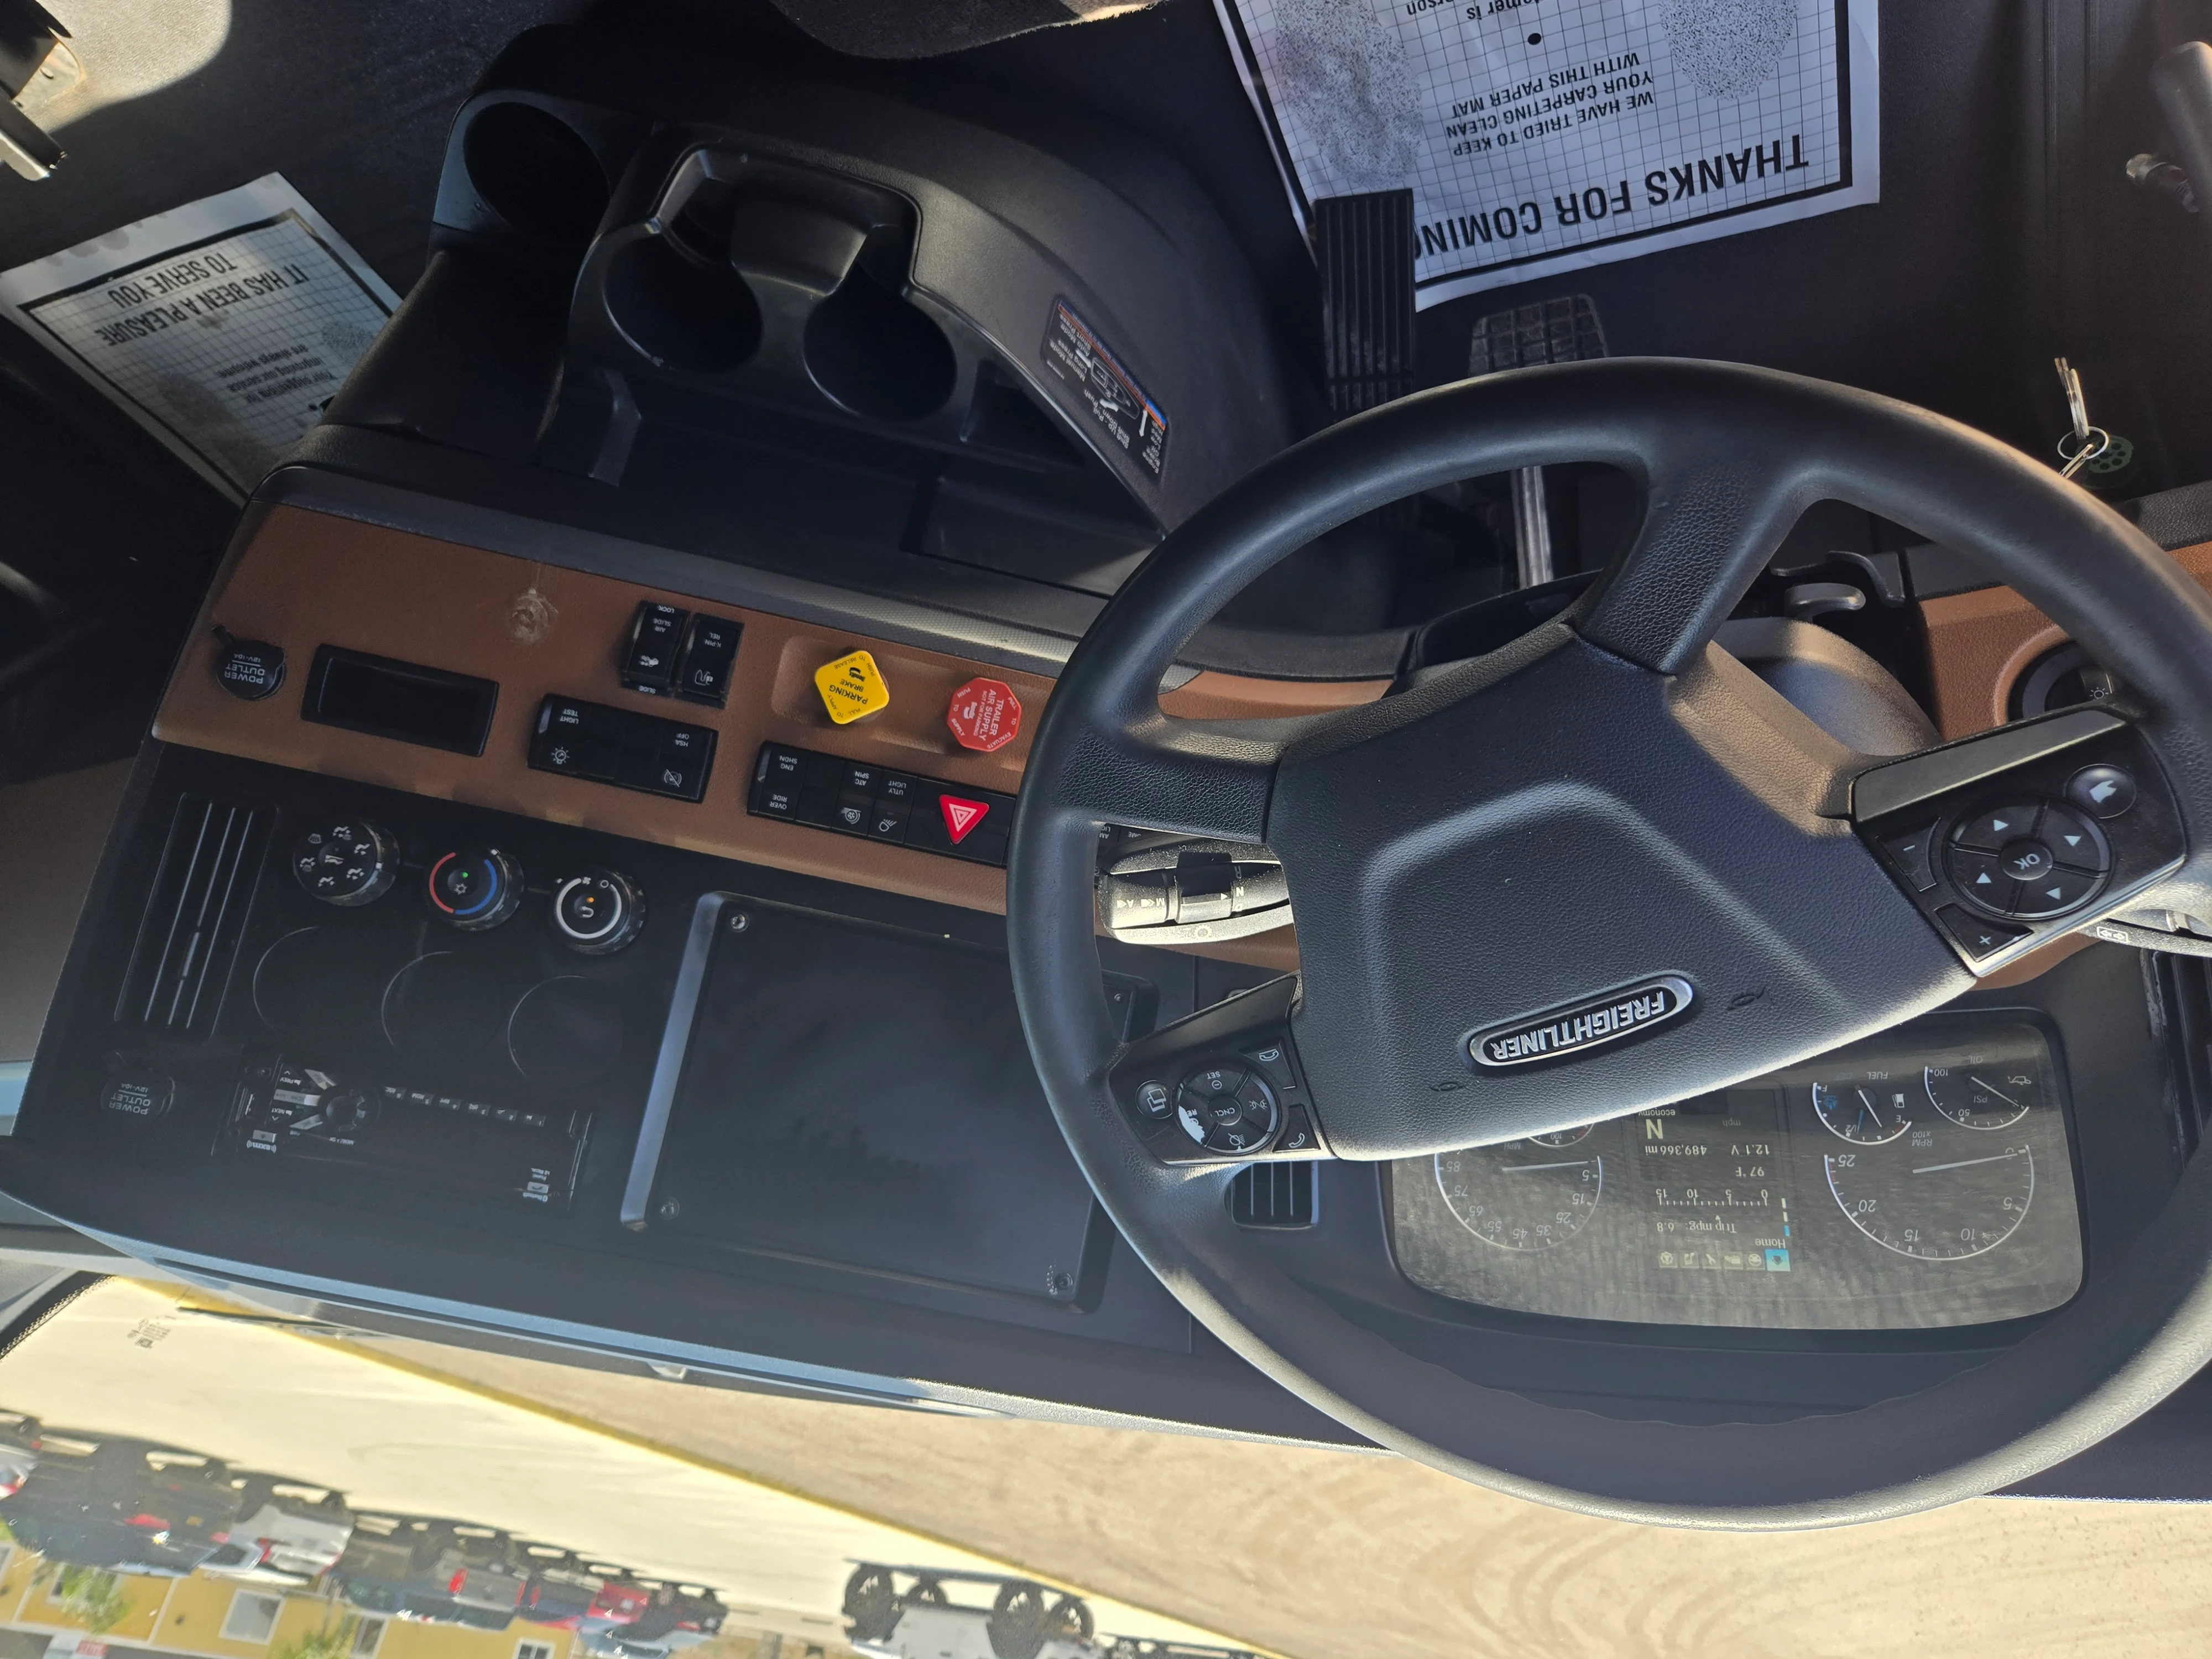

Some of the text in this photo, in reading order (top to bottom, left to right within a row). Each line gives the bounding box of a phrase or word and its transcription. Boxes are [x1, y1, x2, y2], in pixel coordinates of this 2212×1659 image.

[1466, 5, 1482, 20] is
[1450, 52, 1640, 119] WITH THIS PAPER MAT
[1445, 70, 1653, 138] YOUR CARPETING CLEAN
[1453, 91, 1653, 156] WE HAVE TRIED TO KEEP
[1412, 134, 1809, 261] THANKS FOR COMIN
[107, 252, 238, 310] TO SERVE YOU
[93, 263, 310, 347] IT HAS BEEN A PLEASURE
[1066, 356, 1086, 382] Manual
[1083, 388, 1098, 408] Push
[1093, 407, 1104, 422] Pull
[1102, 409, 1118, 430] Down
[1117, 432, 1128, 449] Shift
[658, 605, 675, 614] LOCK
[653, 618, 672, 627] SLIDE
[705, 639, 722, 648] K-PIN
[833, 656, 857, 670] RELEASE
[225, 663, 265, 676] OUTLET
[866, 662, 875, 677] PUSH
[224, 670, 263, 684] POWER
[638, 685, 656, 695] SLIDE
[839, 678, 864, 692] BRAKE
[828, 684, 869, 705] PARKING
[957, 687, 971, 698] PUSH
[827, 694, 837, 710] APPLY
[1008, 696, 1016, 710] PULL
[563, 708, 578, 717] TEST
[847, 707, 861, 716] PULL
[979, 688, 997, 741] AIR SUPPLY
[989, 699, 1004, 736] TRAILER
[560, 715, 579, 724] LIGHT
[973, 713, 982, 736] PARKING
[951, 718, 966, 737] SUPPLY
[675, 739, 688, 748] HSA
[986, 732, 1011, 749] EVACUATE
[779, 755, 798, 764] SHDN
[780, 763, 794, 771] ENG
[854, 771, 870, 779] SPIN
[854, 778, 867, 786] ATC
[888, 780, 906, 789] LIGHT
[888, 787, 904, 796] UTLY
[772, 794, 787, 802] RIDE
[770, 801, 787, 810] OVER
[2013, 852, 2041, 870] OK
[1234, 866, 1241, 879] R
[1235, 886, 1244, 896] N
[1490, 990, 1665, 1060] FREIGHTLINER
[1968, 1055, 1983, 1063] OIL
[1206, 1071, 1221, 1079] SET
[1866, 1071, 1888, 1079] FUEL
[111, 1092, 150, 1107] OUTLET
[109, 1101, 148, 1115] POWER
[1186, 1108, 1198, 1117] RE
[1214, 1107, 1235, 1117] CNCL
[1638, 1108, 1676, 1118] economy
[1645, 1118, 1663, 1140] N
[1722, 1118, 1741, 1128] mph
[1550, 1131, 1562, 1140] 100
[1504, 1141, 1521, 1150] MPH
[1645, 1144, 1707, 1156] 489,366 mi
[1731, 1144, 1770, 1156] 12.1 V
[1446, 1161, 1461, 1172] 85
[1837, 1155, 1855, 1167] 25
[1582, 1168, 1590, 1181] 5
[1750, 1166, 1765, 1177] 97
[1454, 1185, 1468, 1197] 75
[1655, 1188, 1768, 1198] 0 5 10 15
[1572, 1192, 1585, 1204] 15
[2003, 1197, 2013, 1210] 5
[1468, 1205, 1483, 1217] 65
[1858, 1199, 1876, 1212] 20
[1556, 1211, 1572, 1223] 25
[1487, 1220, 1503, 1232] 55
[1536, 1224, 1552, 1236] 35
[1656, 1221, 1737, 1233] Trip mpg: 6.8
[1512, 1228, 1528, 1239] 45
[1904, 1229, 1919, 1241] 15
[1960, 1228, 1975, 1241] 10
[1754, 1238, 1786, 1249] Home
